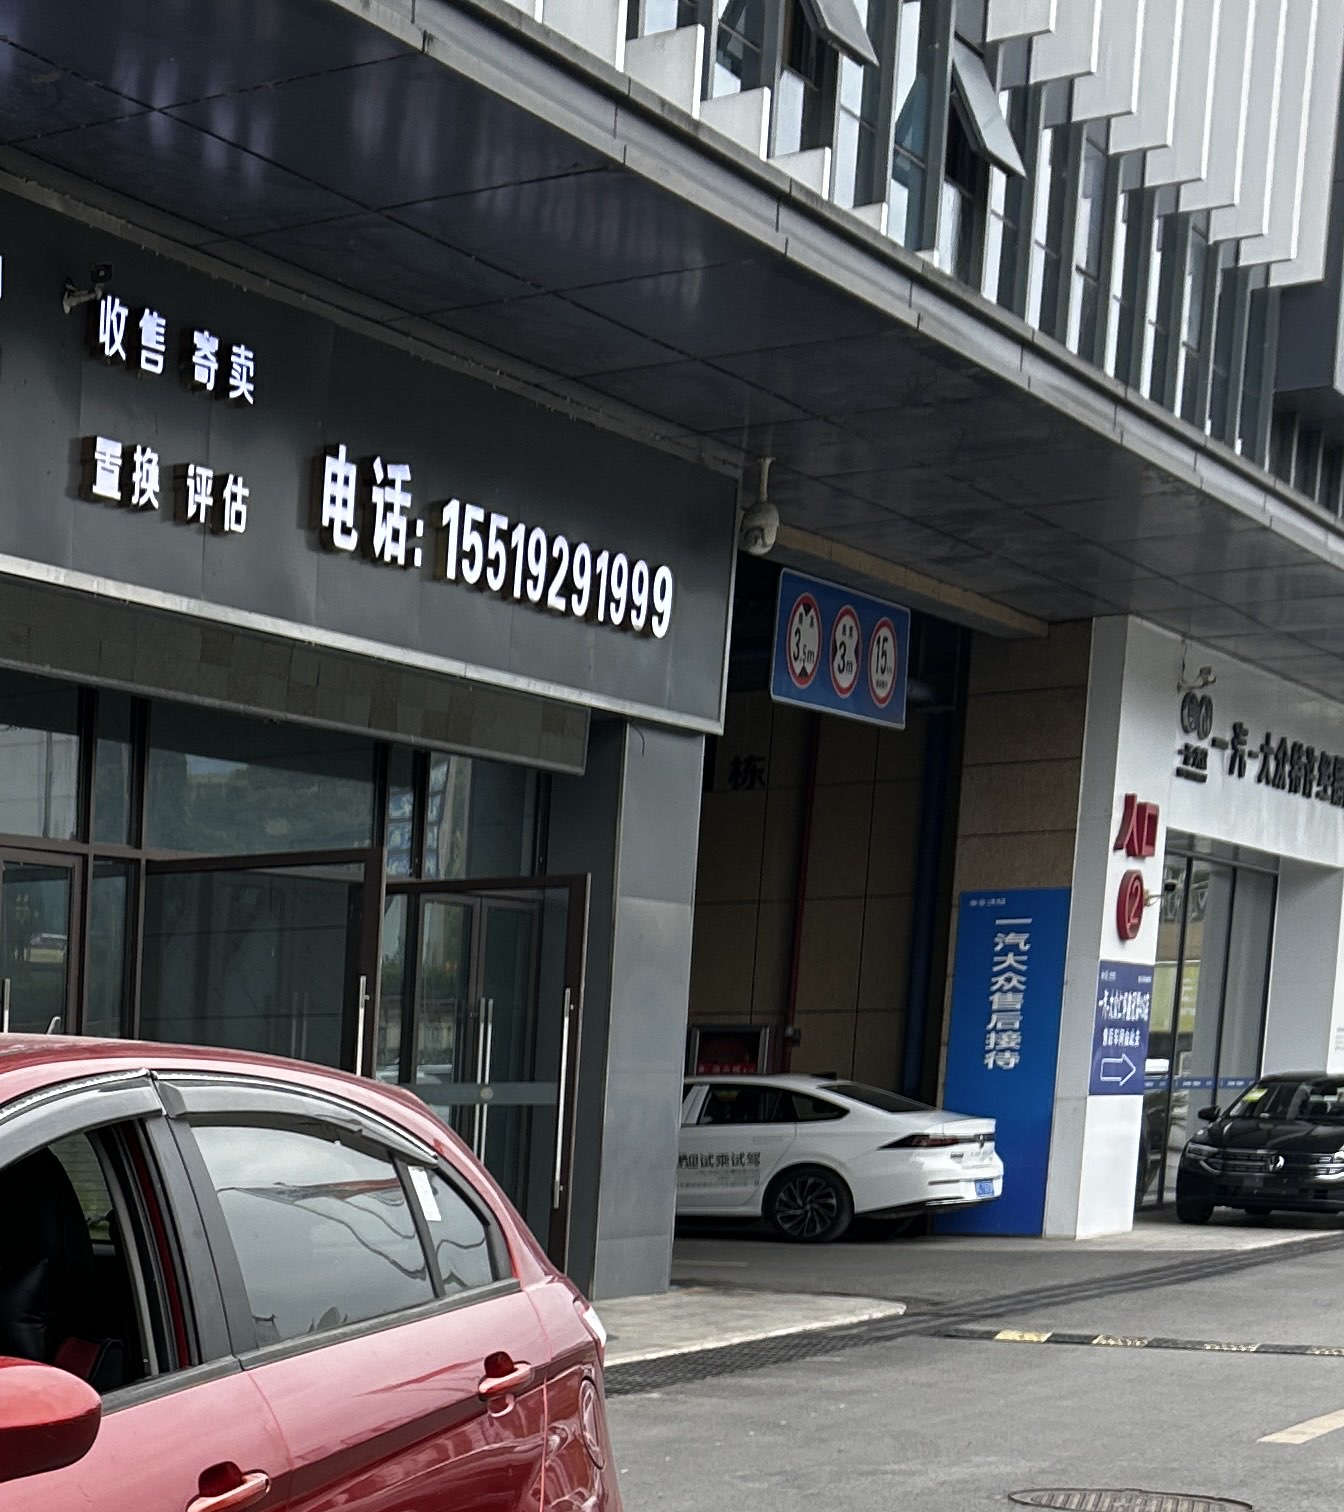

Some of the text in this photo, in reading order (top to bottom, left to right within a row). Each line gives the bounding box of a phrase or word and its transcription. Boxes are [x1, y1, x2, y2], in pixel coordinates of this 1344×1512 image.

[98, 296, 255, 405] 收售 寄卖
[93, 436, 250, 534] 置换 评估
[1113, 793, 1160, 858] 入口
[984, 917, 1033, 1070] 一汽大众售后接待
